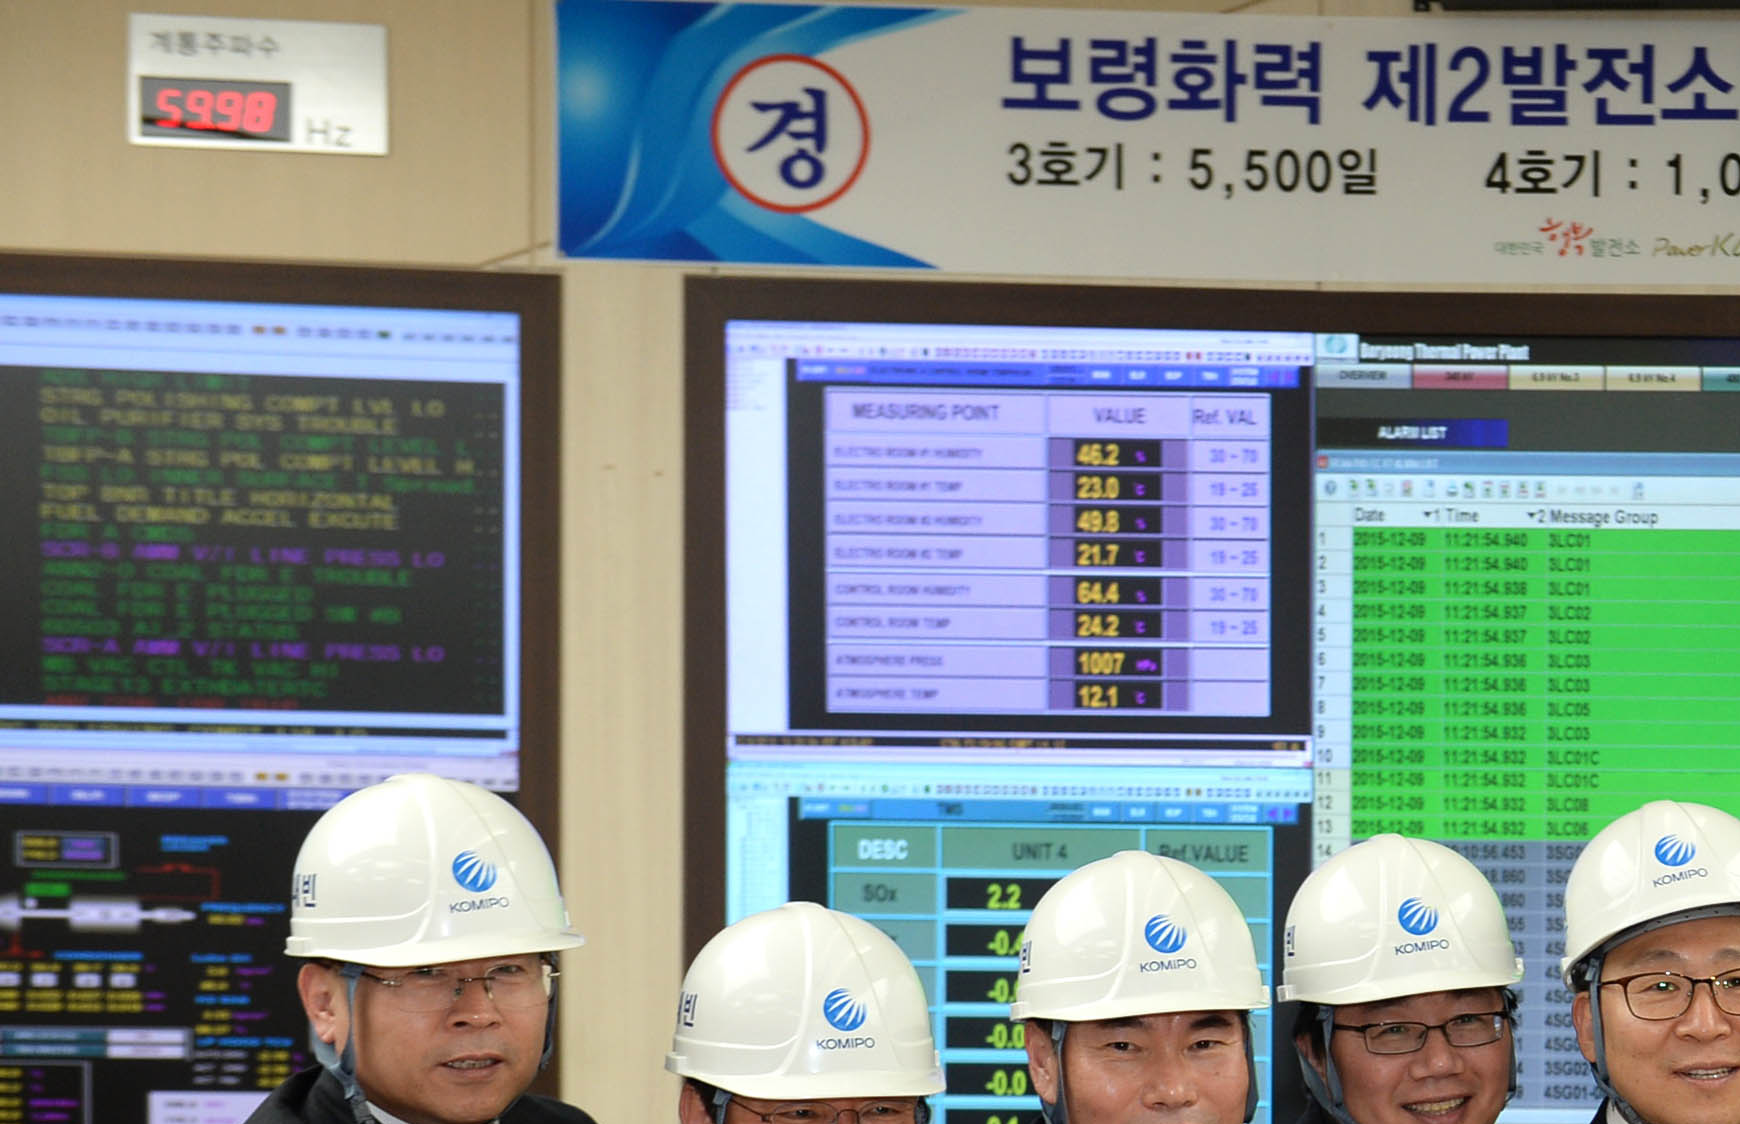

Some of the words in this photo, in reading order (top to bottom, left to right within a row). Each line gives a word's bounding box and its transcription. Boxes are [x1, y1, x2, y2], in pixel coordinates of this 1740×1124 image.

[1001, 35, 1324, 125] 보령화력
[1362, 41, 1740, 127] 제2발전소
[305, 118, 352, 147] Hz
[745, 88, 829, 190] 경
[1007, 142, 1127, 191] 3호기
[1485, 150, 1601, 197] 4호기
[853, 403, 948, 420] MEASURING
[952, 404, 999, 420] POINT
[1093, 408, 1147, 424] VALUE
[1226, 410, 1257, 426] VAL
[1421, 427, 1447, 439] LIST
[1077, 443, 1120, 466] 46.2
[1077, 476, 1120, 499] 23.0
[1077, 510, 1120, 533] 49.8
[1355, 506, 1386, 522] Date
[1446, 508, 1480, 523] Time
[1550, 508, 1611, 528] Message
[1614, 508, 1658, 528] Group
[1077, 544, 1120, 567] 21.7
[1077, 581, 1120, 604] 64.4
[1077, 614, 1120, 637] 24.2
[1078, 652, 1126, 675] 1007
[1078, 685, 1119, 708] 12.1
[857, 839, 909, 860] DESC
[1012, 842, 1053, 861] UNIT
[1056, 843, 1068, 860] 4
[1653, 867, 1709, 888] KOMIPO
[449, 896, 510, 914] KOMIPO
[987, 884, 1021, 909] 2.2
[1395, 938, 1450, 956] KOMIPO
[1139, 958, 1197, 972] KOMIPO
[816, 1037, 875, 1050] KOMIPO
[985, 1070, 1027, 1096] -0.0
